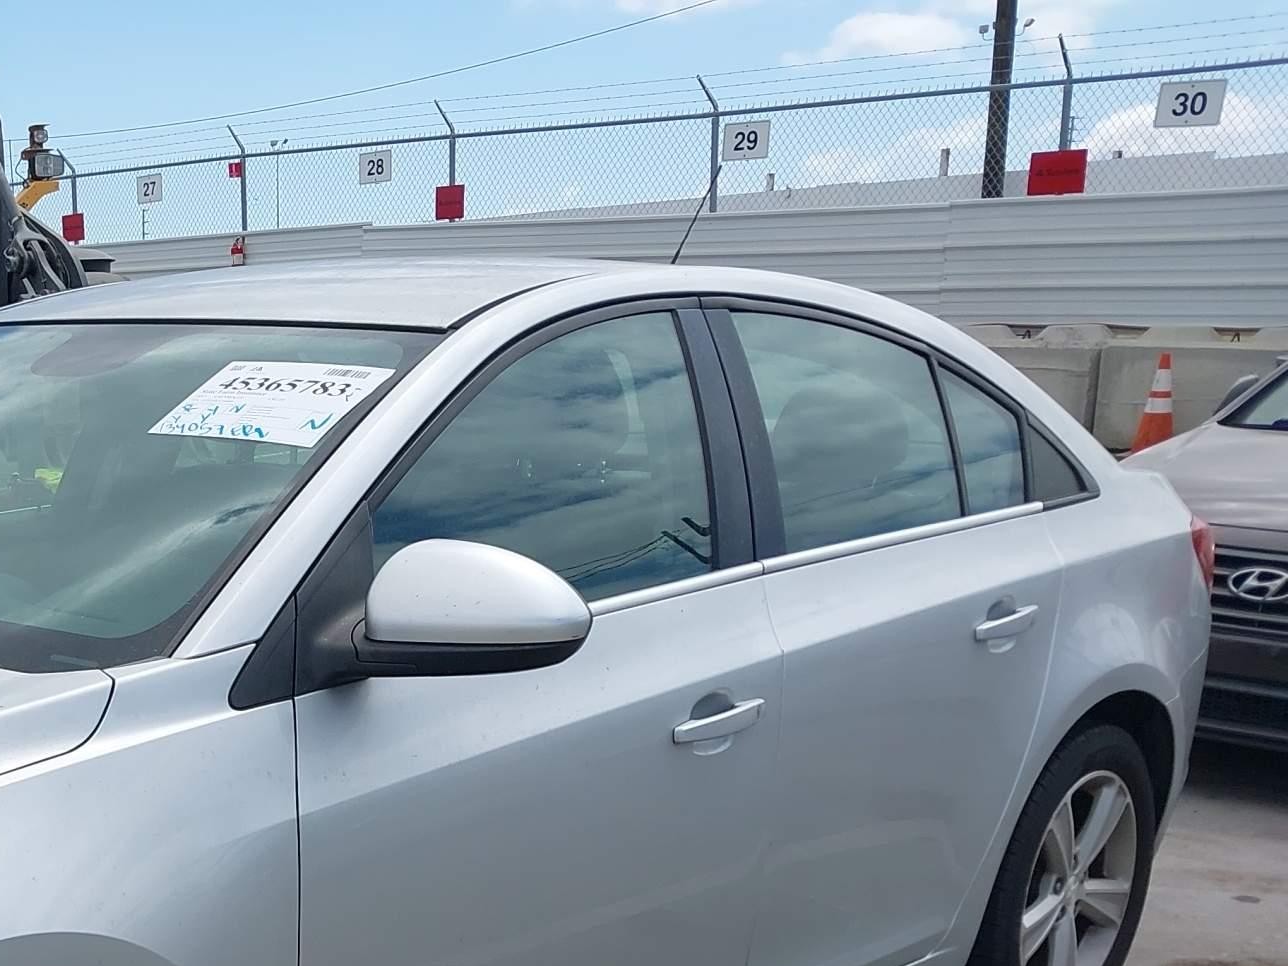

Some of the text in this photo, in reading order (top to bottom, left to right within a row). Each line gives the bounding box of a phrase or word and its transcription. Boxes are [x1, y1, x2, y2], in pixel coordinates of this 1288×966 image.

[1171, 91, 1208, 117] 30
[733, 130, 758, 152] 29
[367, 158, 385, 177] 28
[143, 180, 156, 197] 27
[218, 376, 352, 397] 45365783
